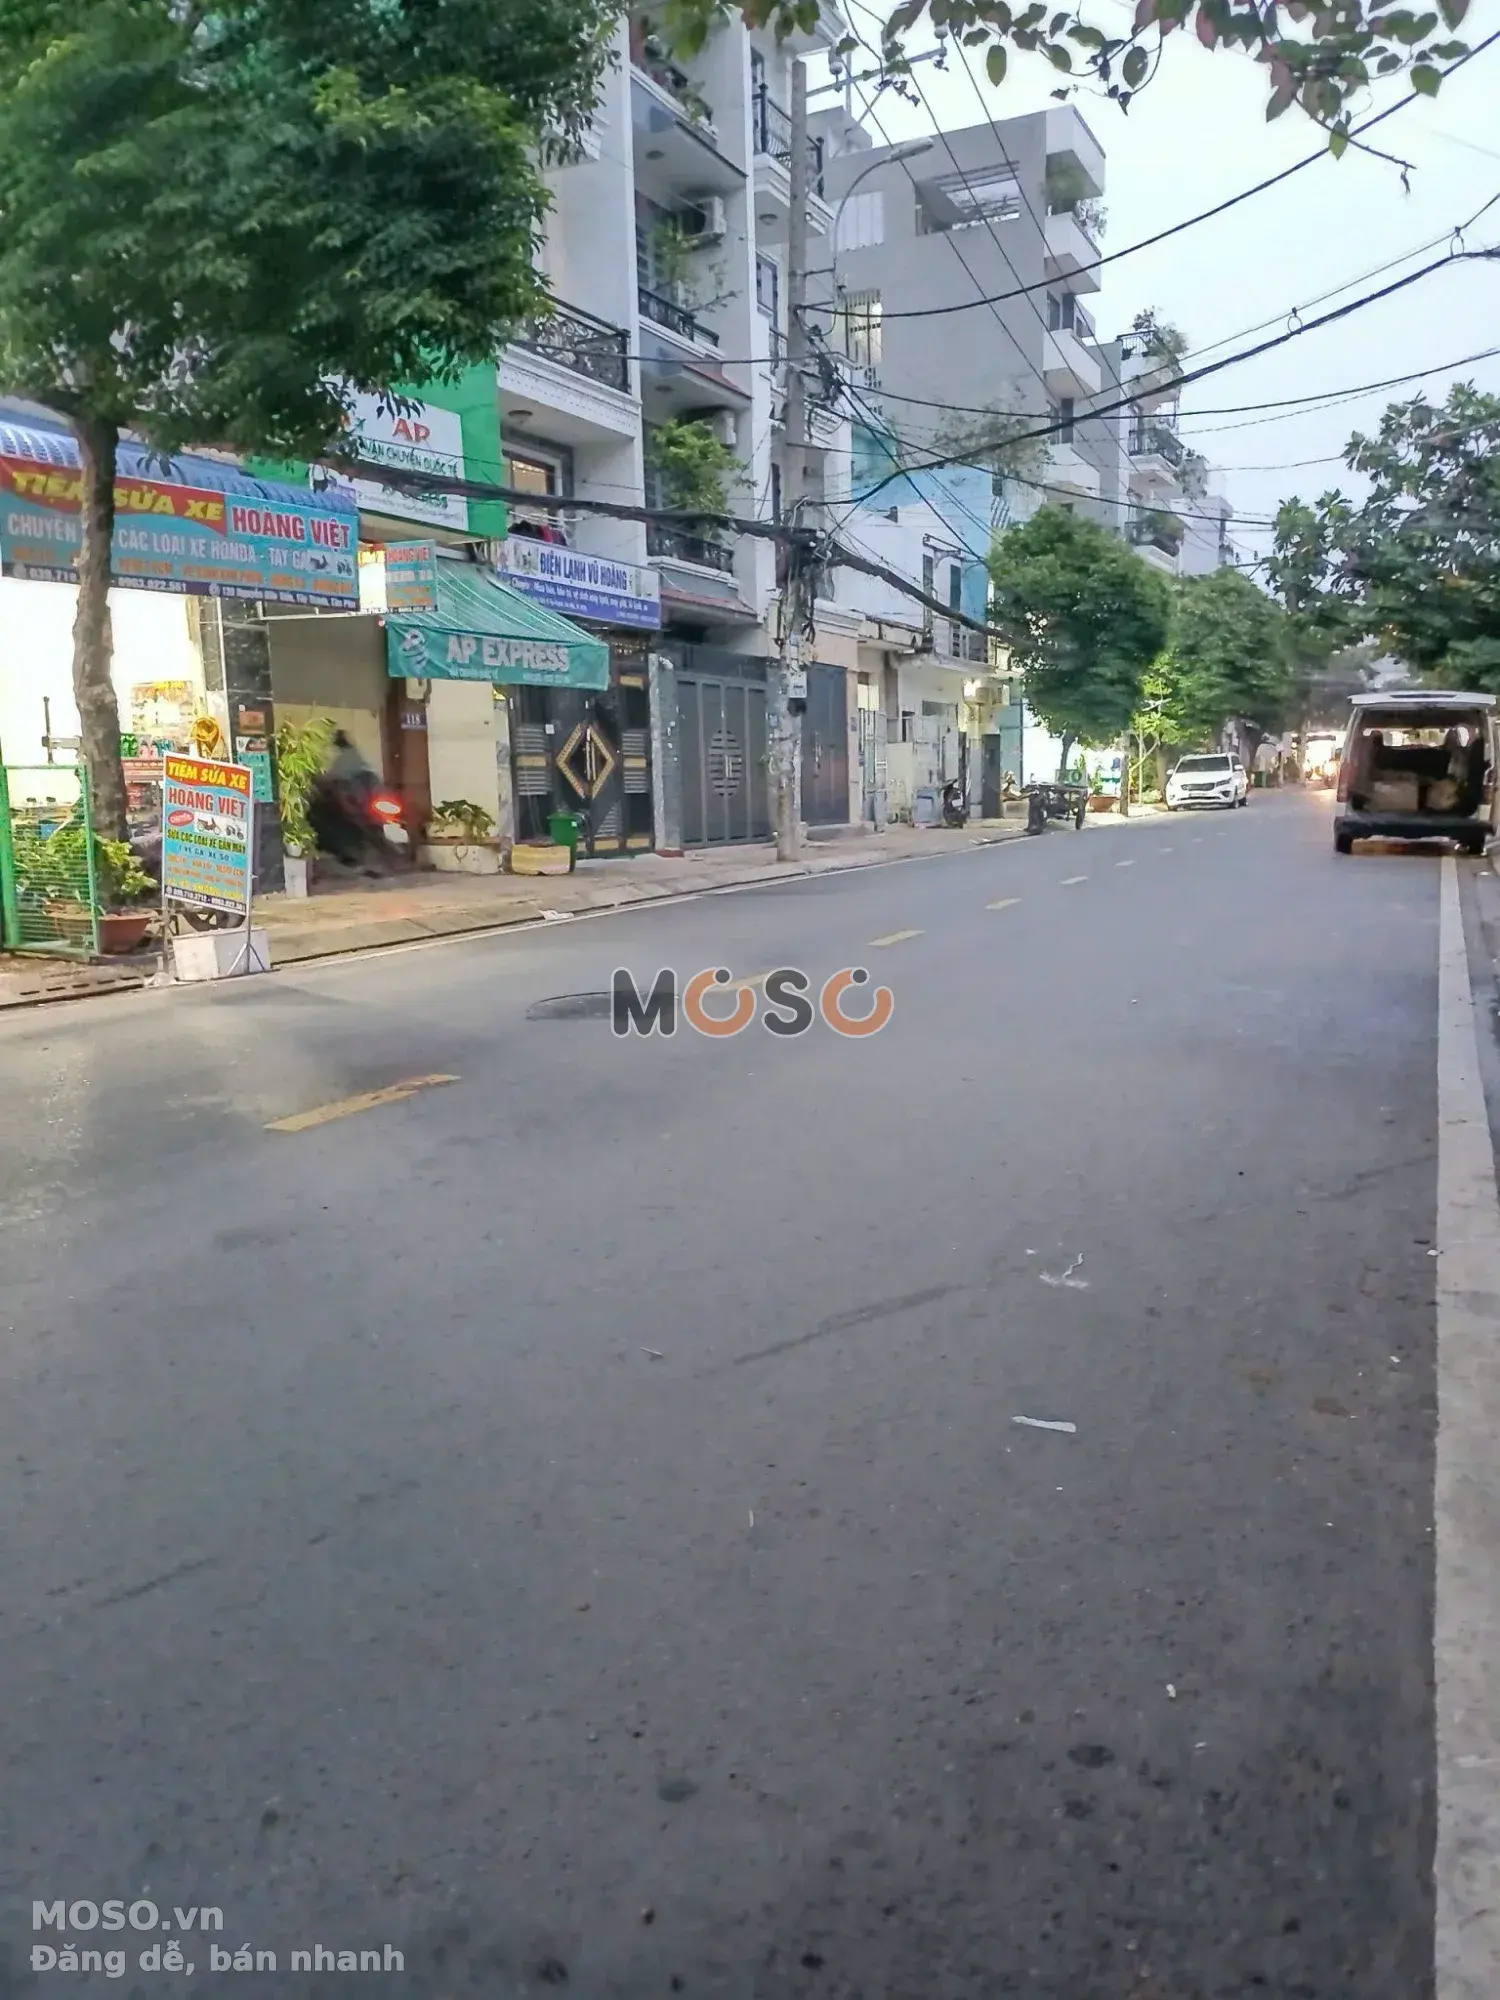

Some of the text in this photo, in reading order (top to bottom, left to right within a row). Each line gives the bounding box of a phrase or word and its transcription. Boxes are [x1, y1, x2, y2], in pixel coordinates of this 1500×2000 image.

[113, 484, 175, 515] SỬA
[183, 499, 224, 522] XE
[118, 524, 149, 551] CÁC
[153, 532, 184, 560] LOẠI
[190, 538, 206, 558] XE
[211, 540, 258, 569] HONDA
[268, 547, 288, 567] TAY
[231, 505, 351, 552] HOÀNG VIỆT
[540, 550, 562, 580] ĐIỆN
[563, 557, 587, 584] LẠNH
[600, 564, 628, 591] HOÀNG
[446, 635, 477, 664] AP
[482, 639, 569, 673] EXPRESS
[168, 760, 198, 782] TIỆM
[200, 765, 227, 786] SỬA
[229, 773, 248, 790] XE
[168, 786, 247, 820] HOÀNG VIỆT
